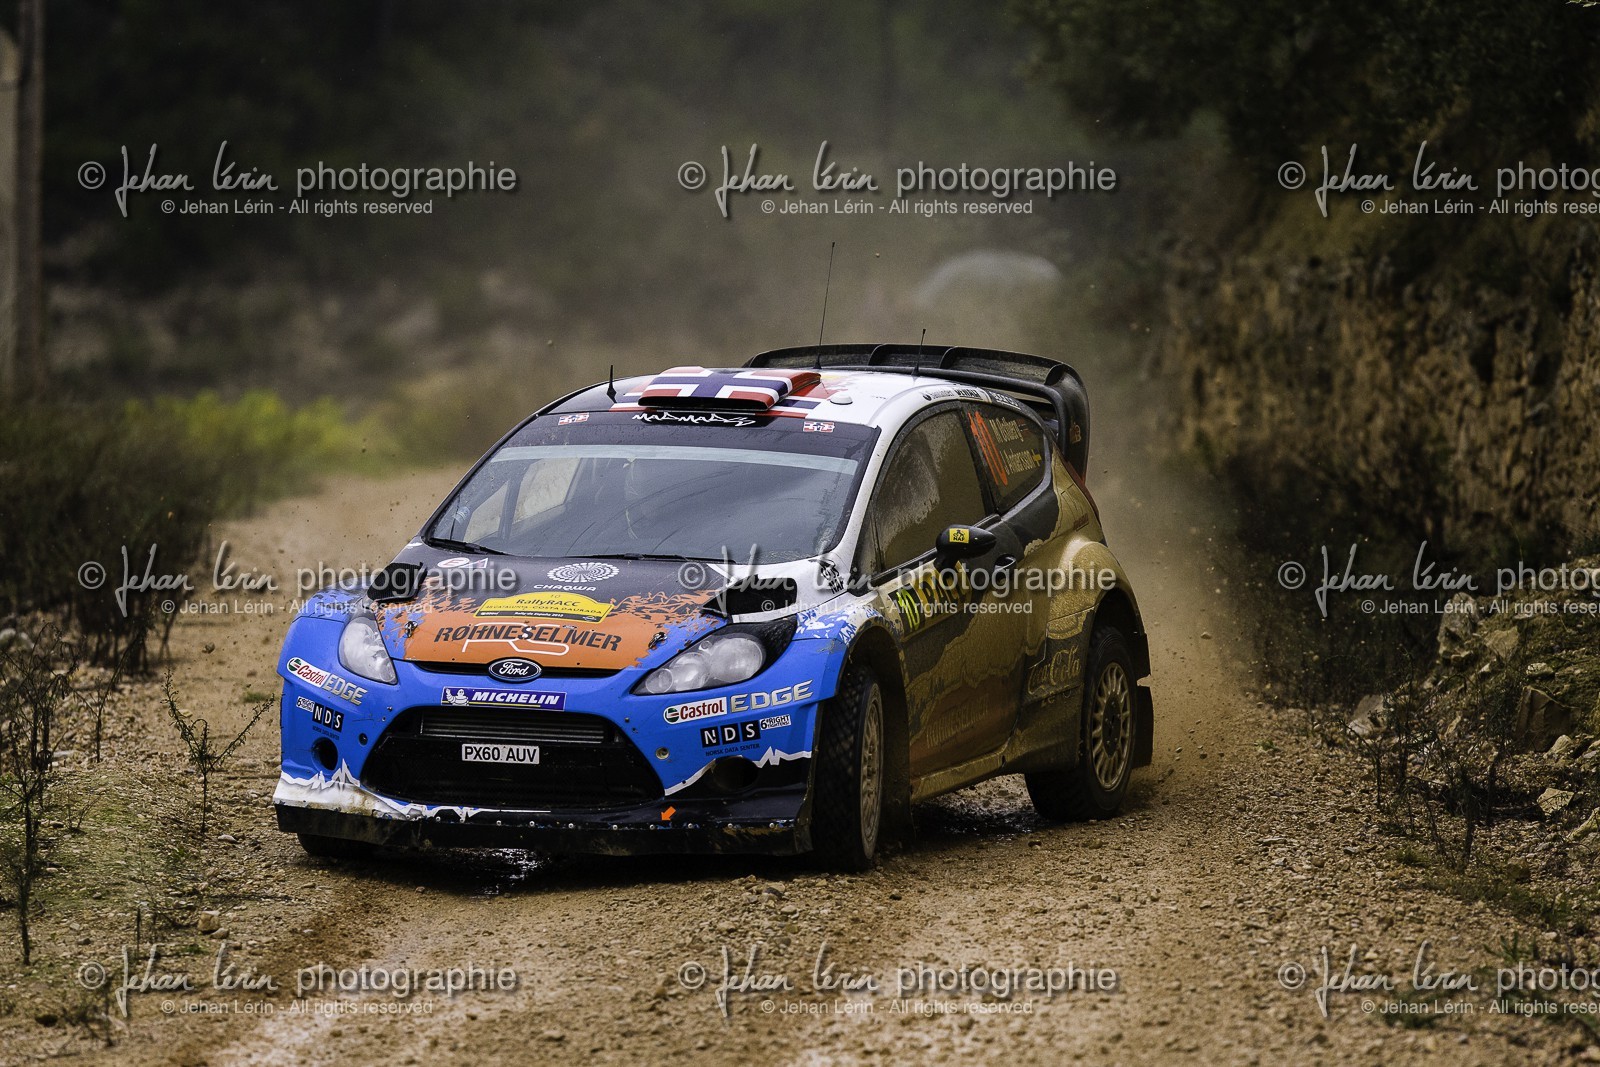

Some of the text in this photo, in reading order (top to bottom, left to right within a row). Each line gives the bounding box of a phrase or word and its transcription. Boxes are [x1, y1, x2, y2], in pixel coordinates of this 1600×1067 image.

[534, 584, 596, 592] CHAQWA
[516, 599, 582, 608] RallyRACC
[499, 661, 530, 676] Ford
[296, 664, 327, 686] Castrol
[322, 674, 368, 706] EDGE
[471, 691, 560, 705] MICHELIN
[678, 679, 813, 721] Castrol EDGE
[464, 746, 537, 763] PX60 AUV
